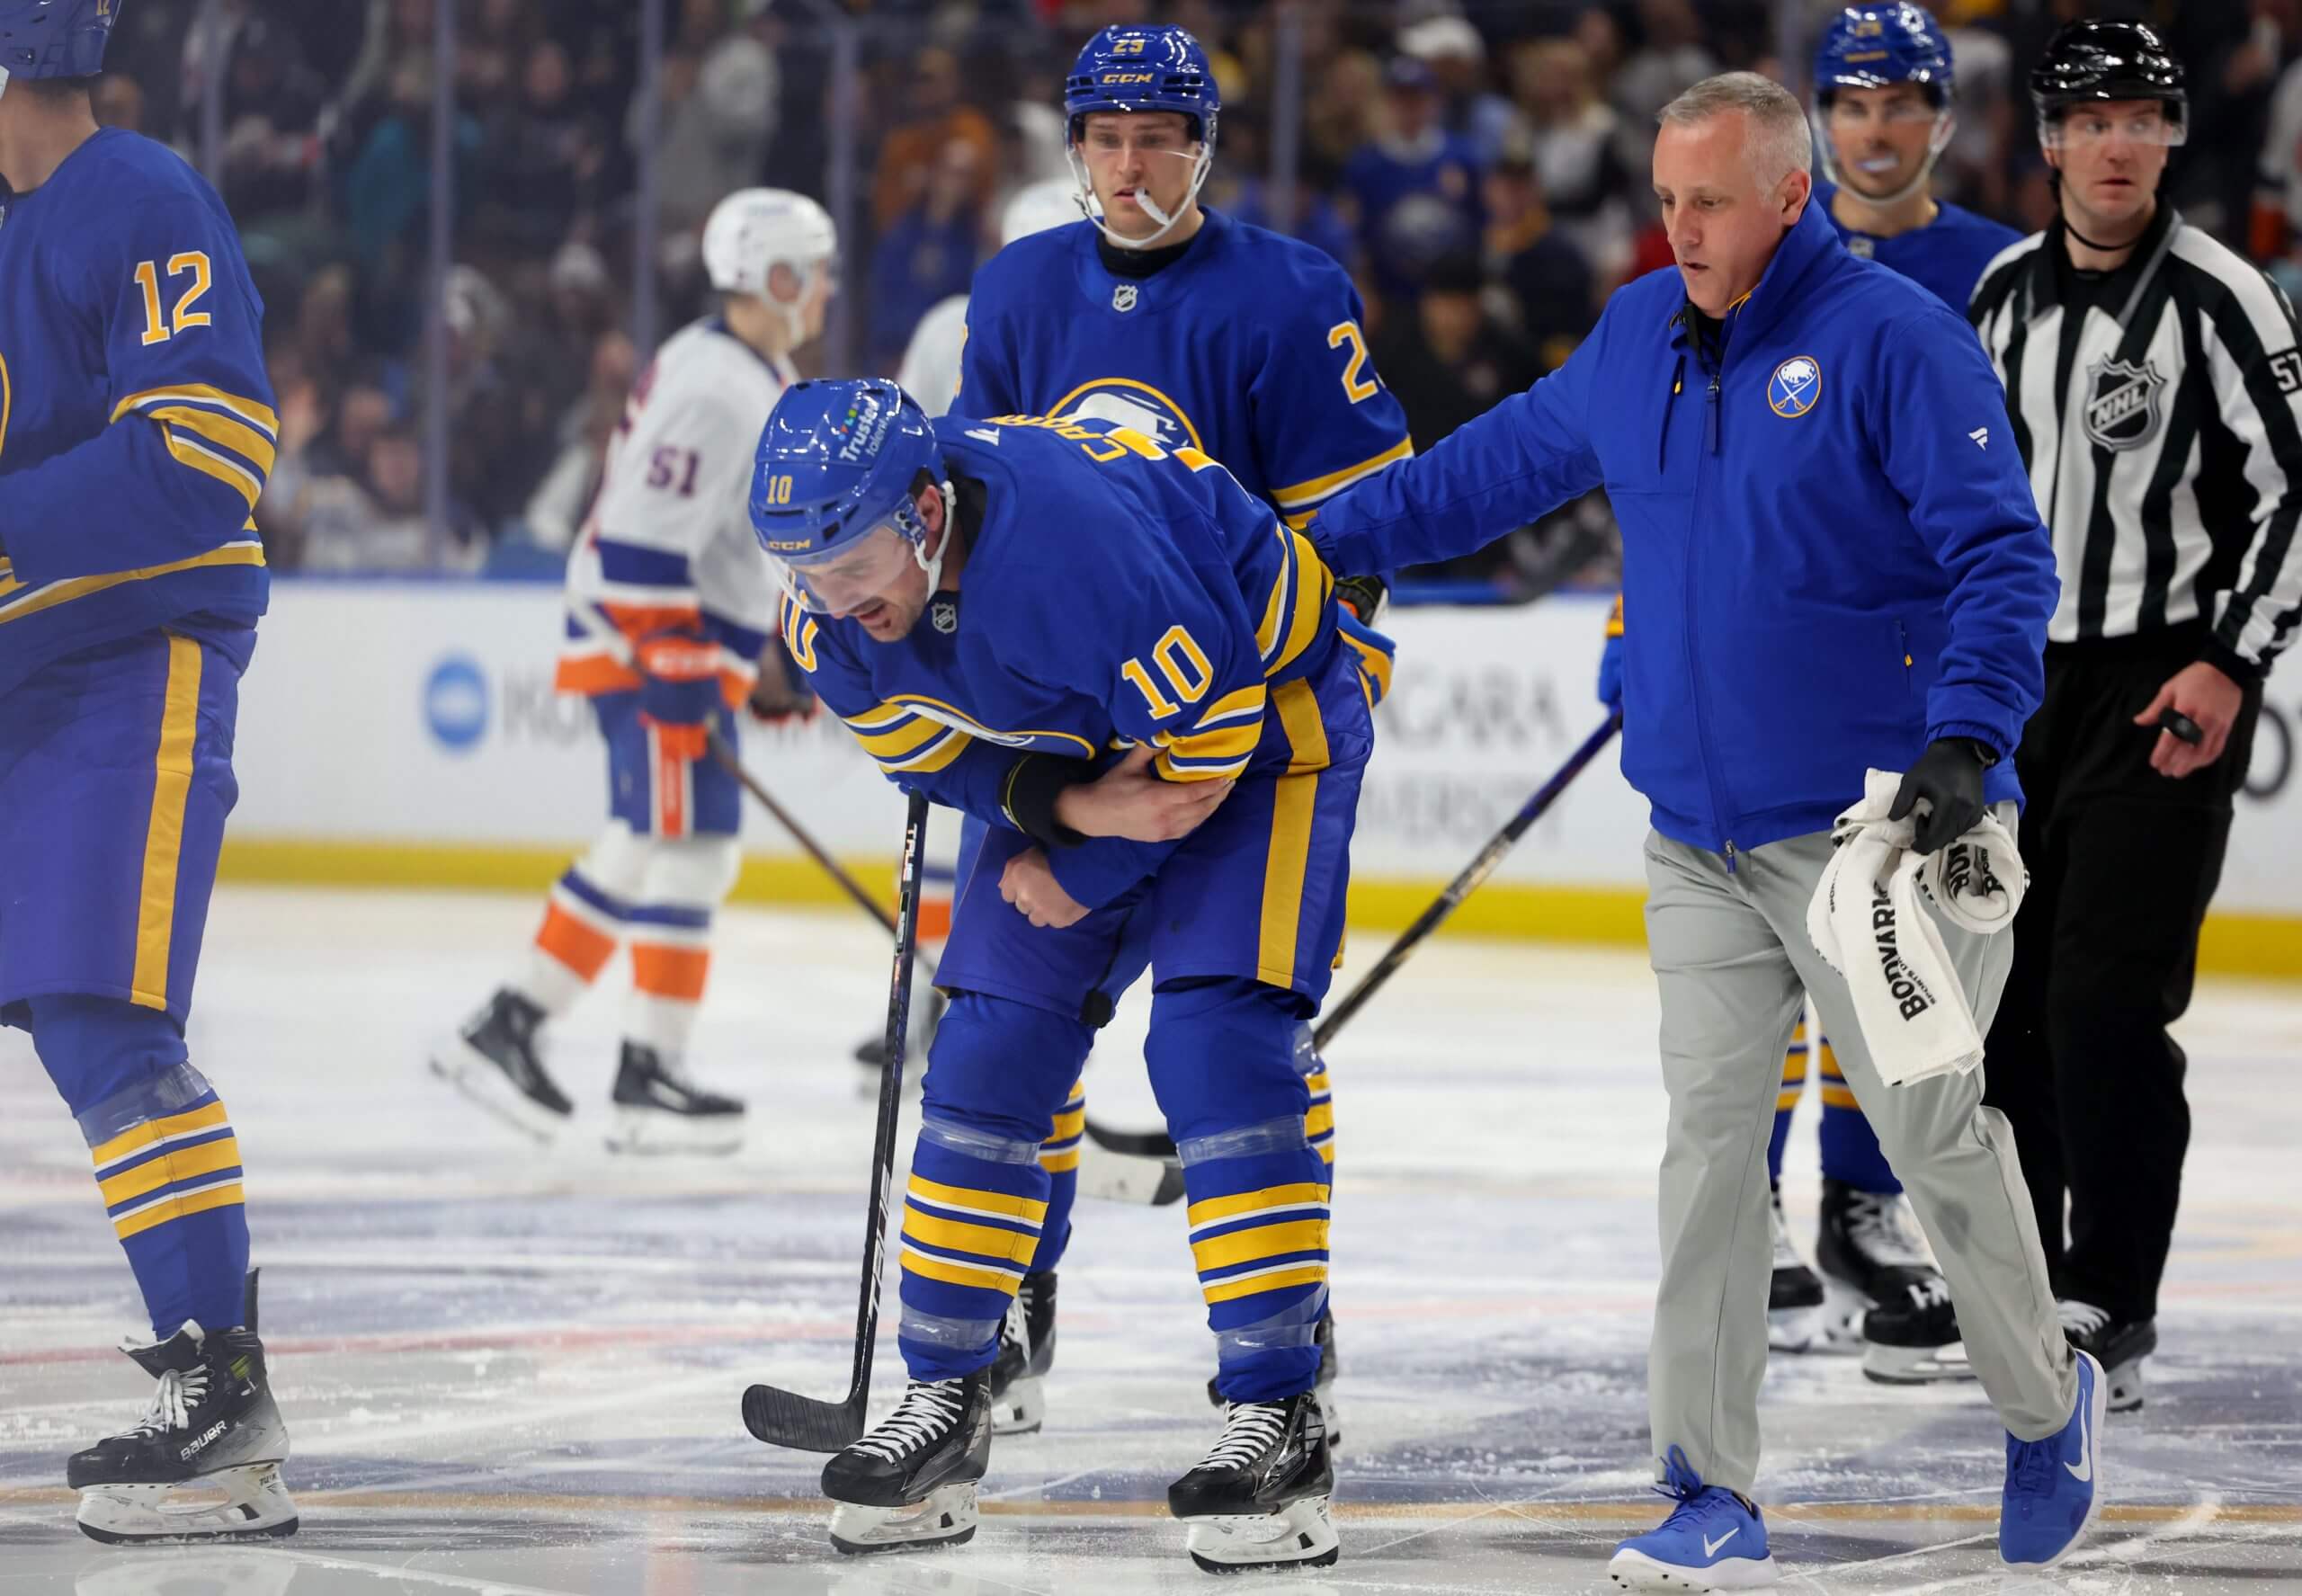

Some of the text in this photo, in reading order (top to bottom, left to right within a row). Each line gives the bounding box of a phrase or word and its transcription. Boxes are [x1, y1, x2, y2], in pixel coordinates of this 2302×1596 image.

[1102, 73, 1154, 85] CCM
[134, 250, 211, 346] 12
[1327, 320, 1386, 404] 2
[839, 398, 879, 460] Trusted
[2094, 385, 2145, 427] NHL
[645, 448, 701, 498] 51
[767, 475, 792, 504] 10
[768, 539, 811, 551] CCM
[1121, 625, 1214, 720] 10
[181, 1420, 228, 1461] BAUER
